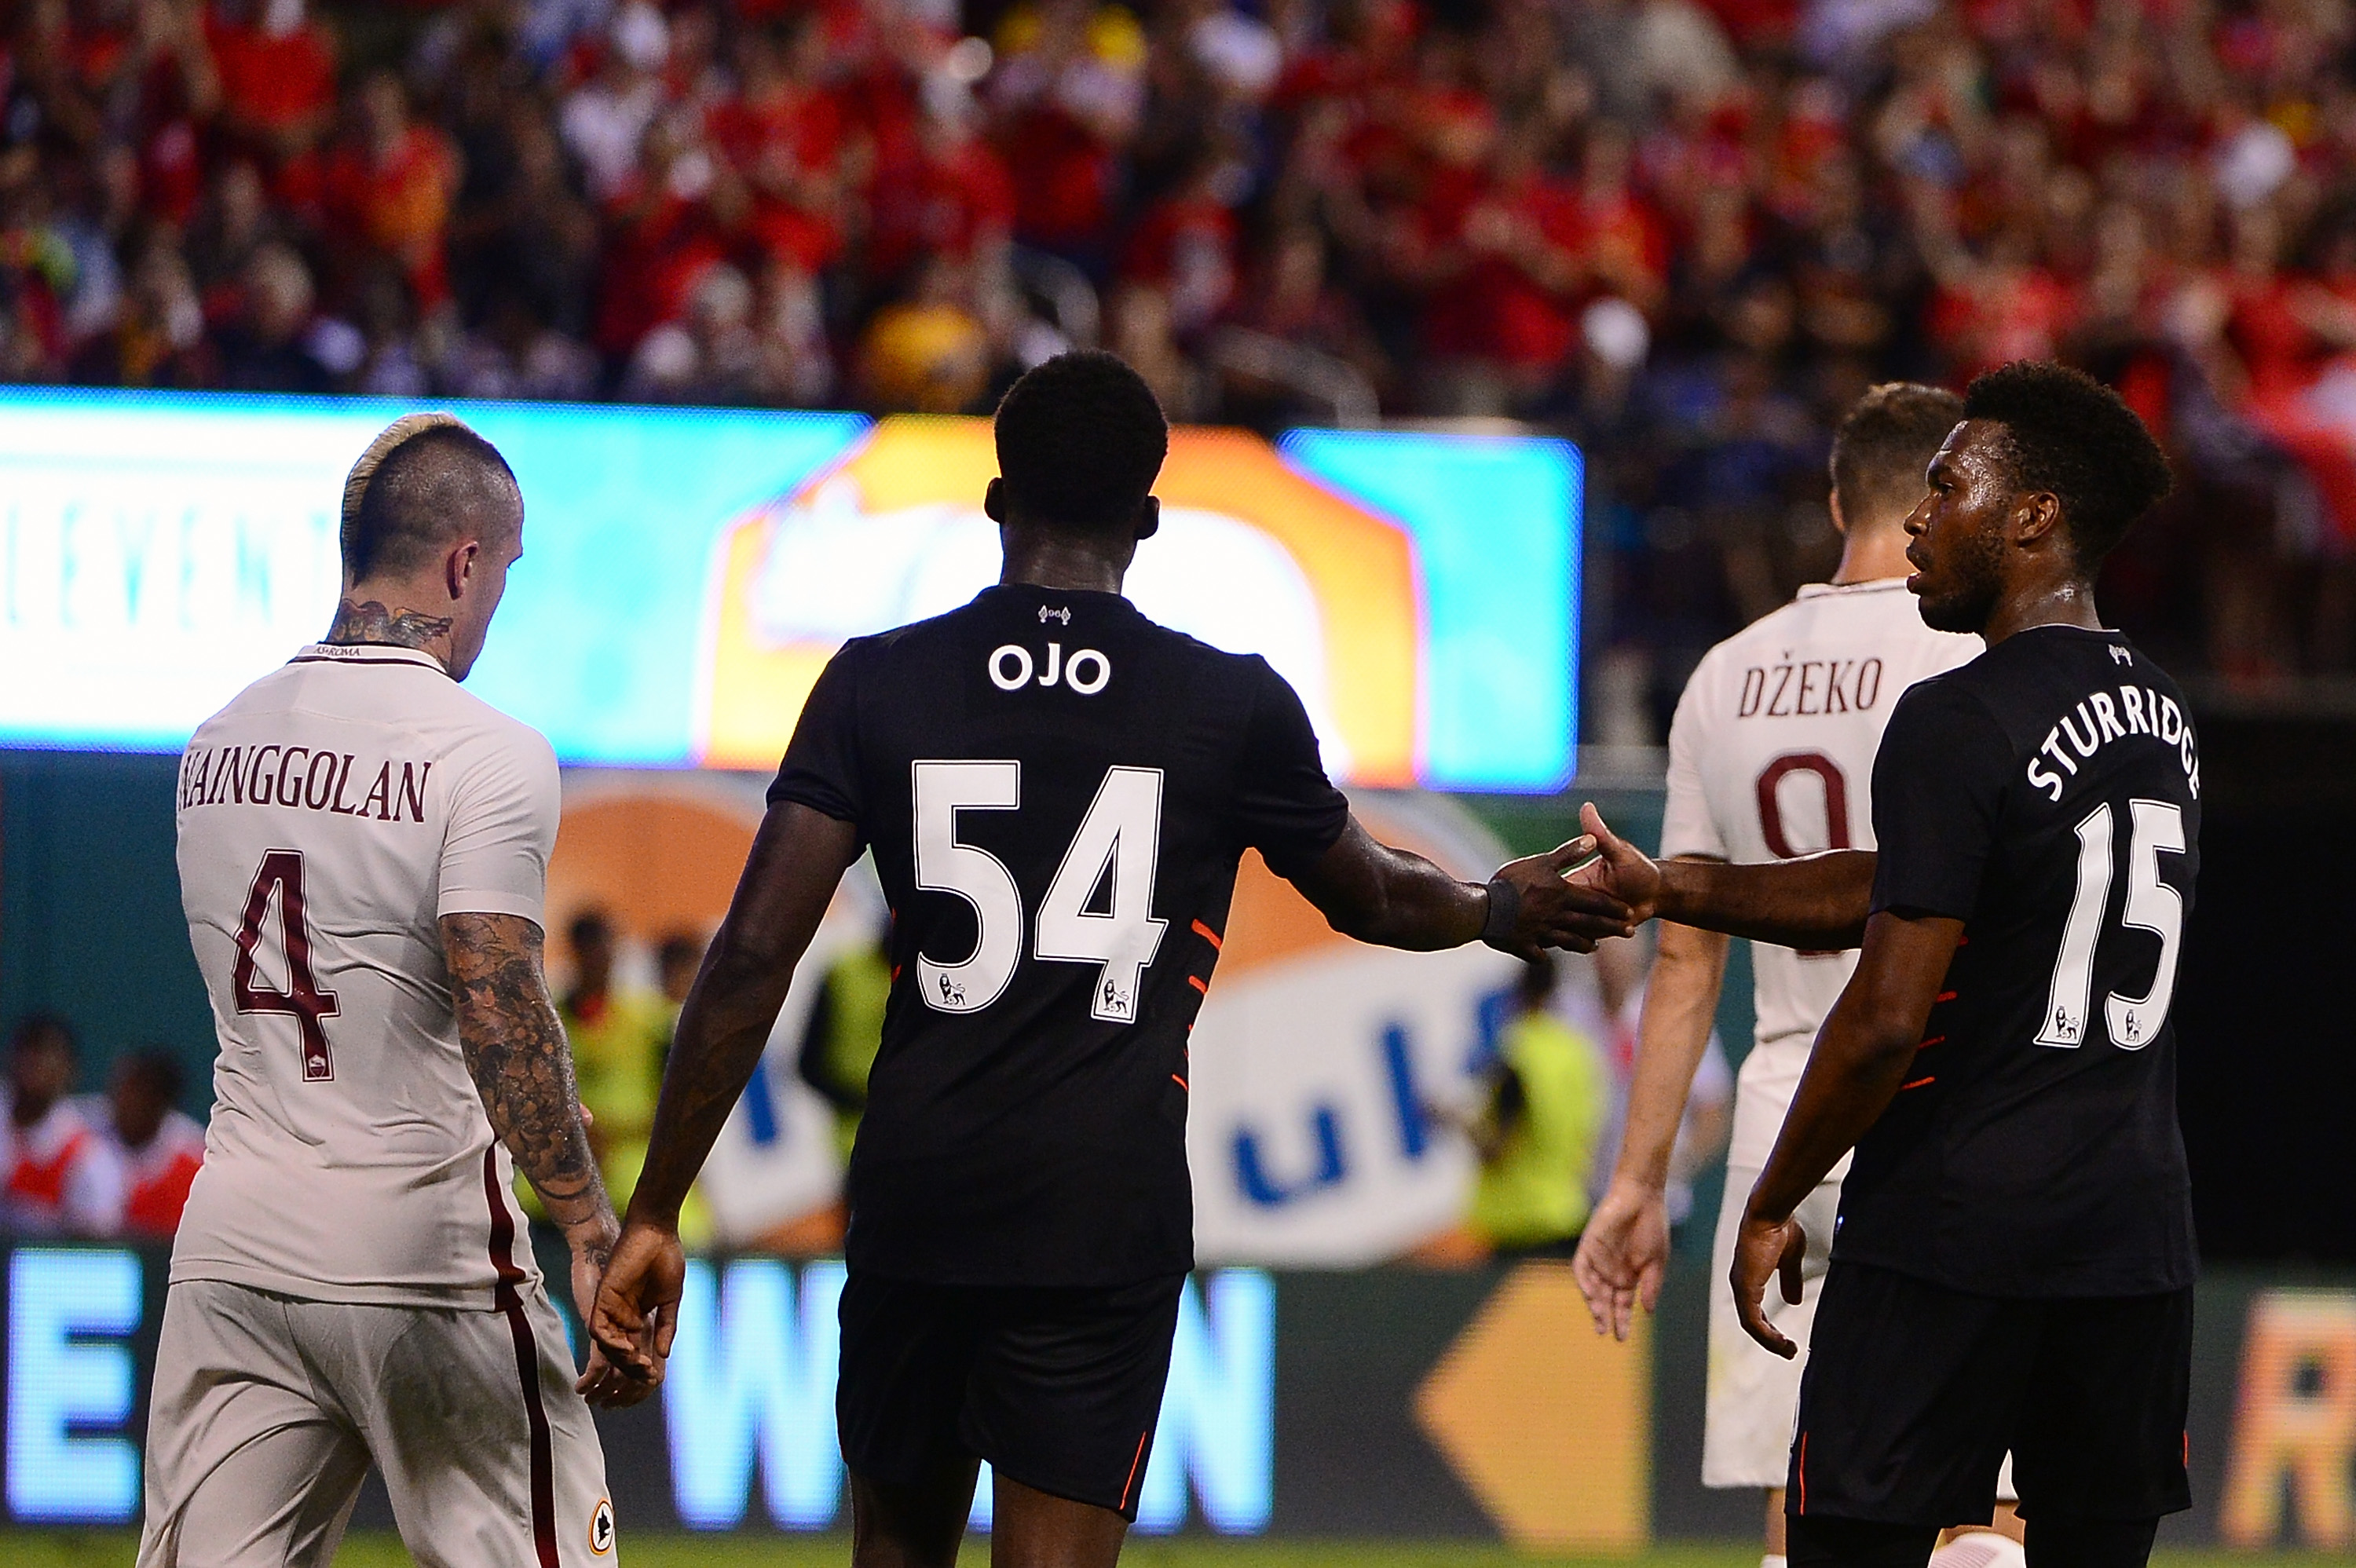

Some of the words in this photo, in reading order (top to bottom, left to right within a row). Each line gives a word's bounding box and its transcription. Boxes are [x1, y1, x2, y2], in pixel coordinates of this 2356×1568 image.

[988, 641, 1111, 696] OJO
[1738, 649, 1883, 719] DŽEKO
[230, 848, 342, 1083] 4
[911, 759, 1169, 1025] 54
[2032, 798, 2186, 1051] 15
